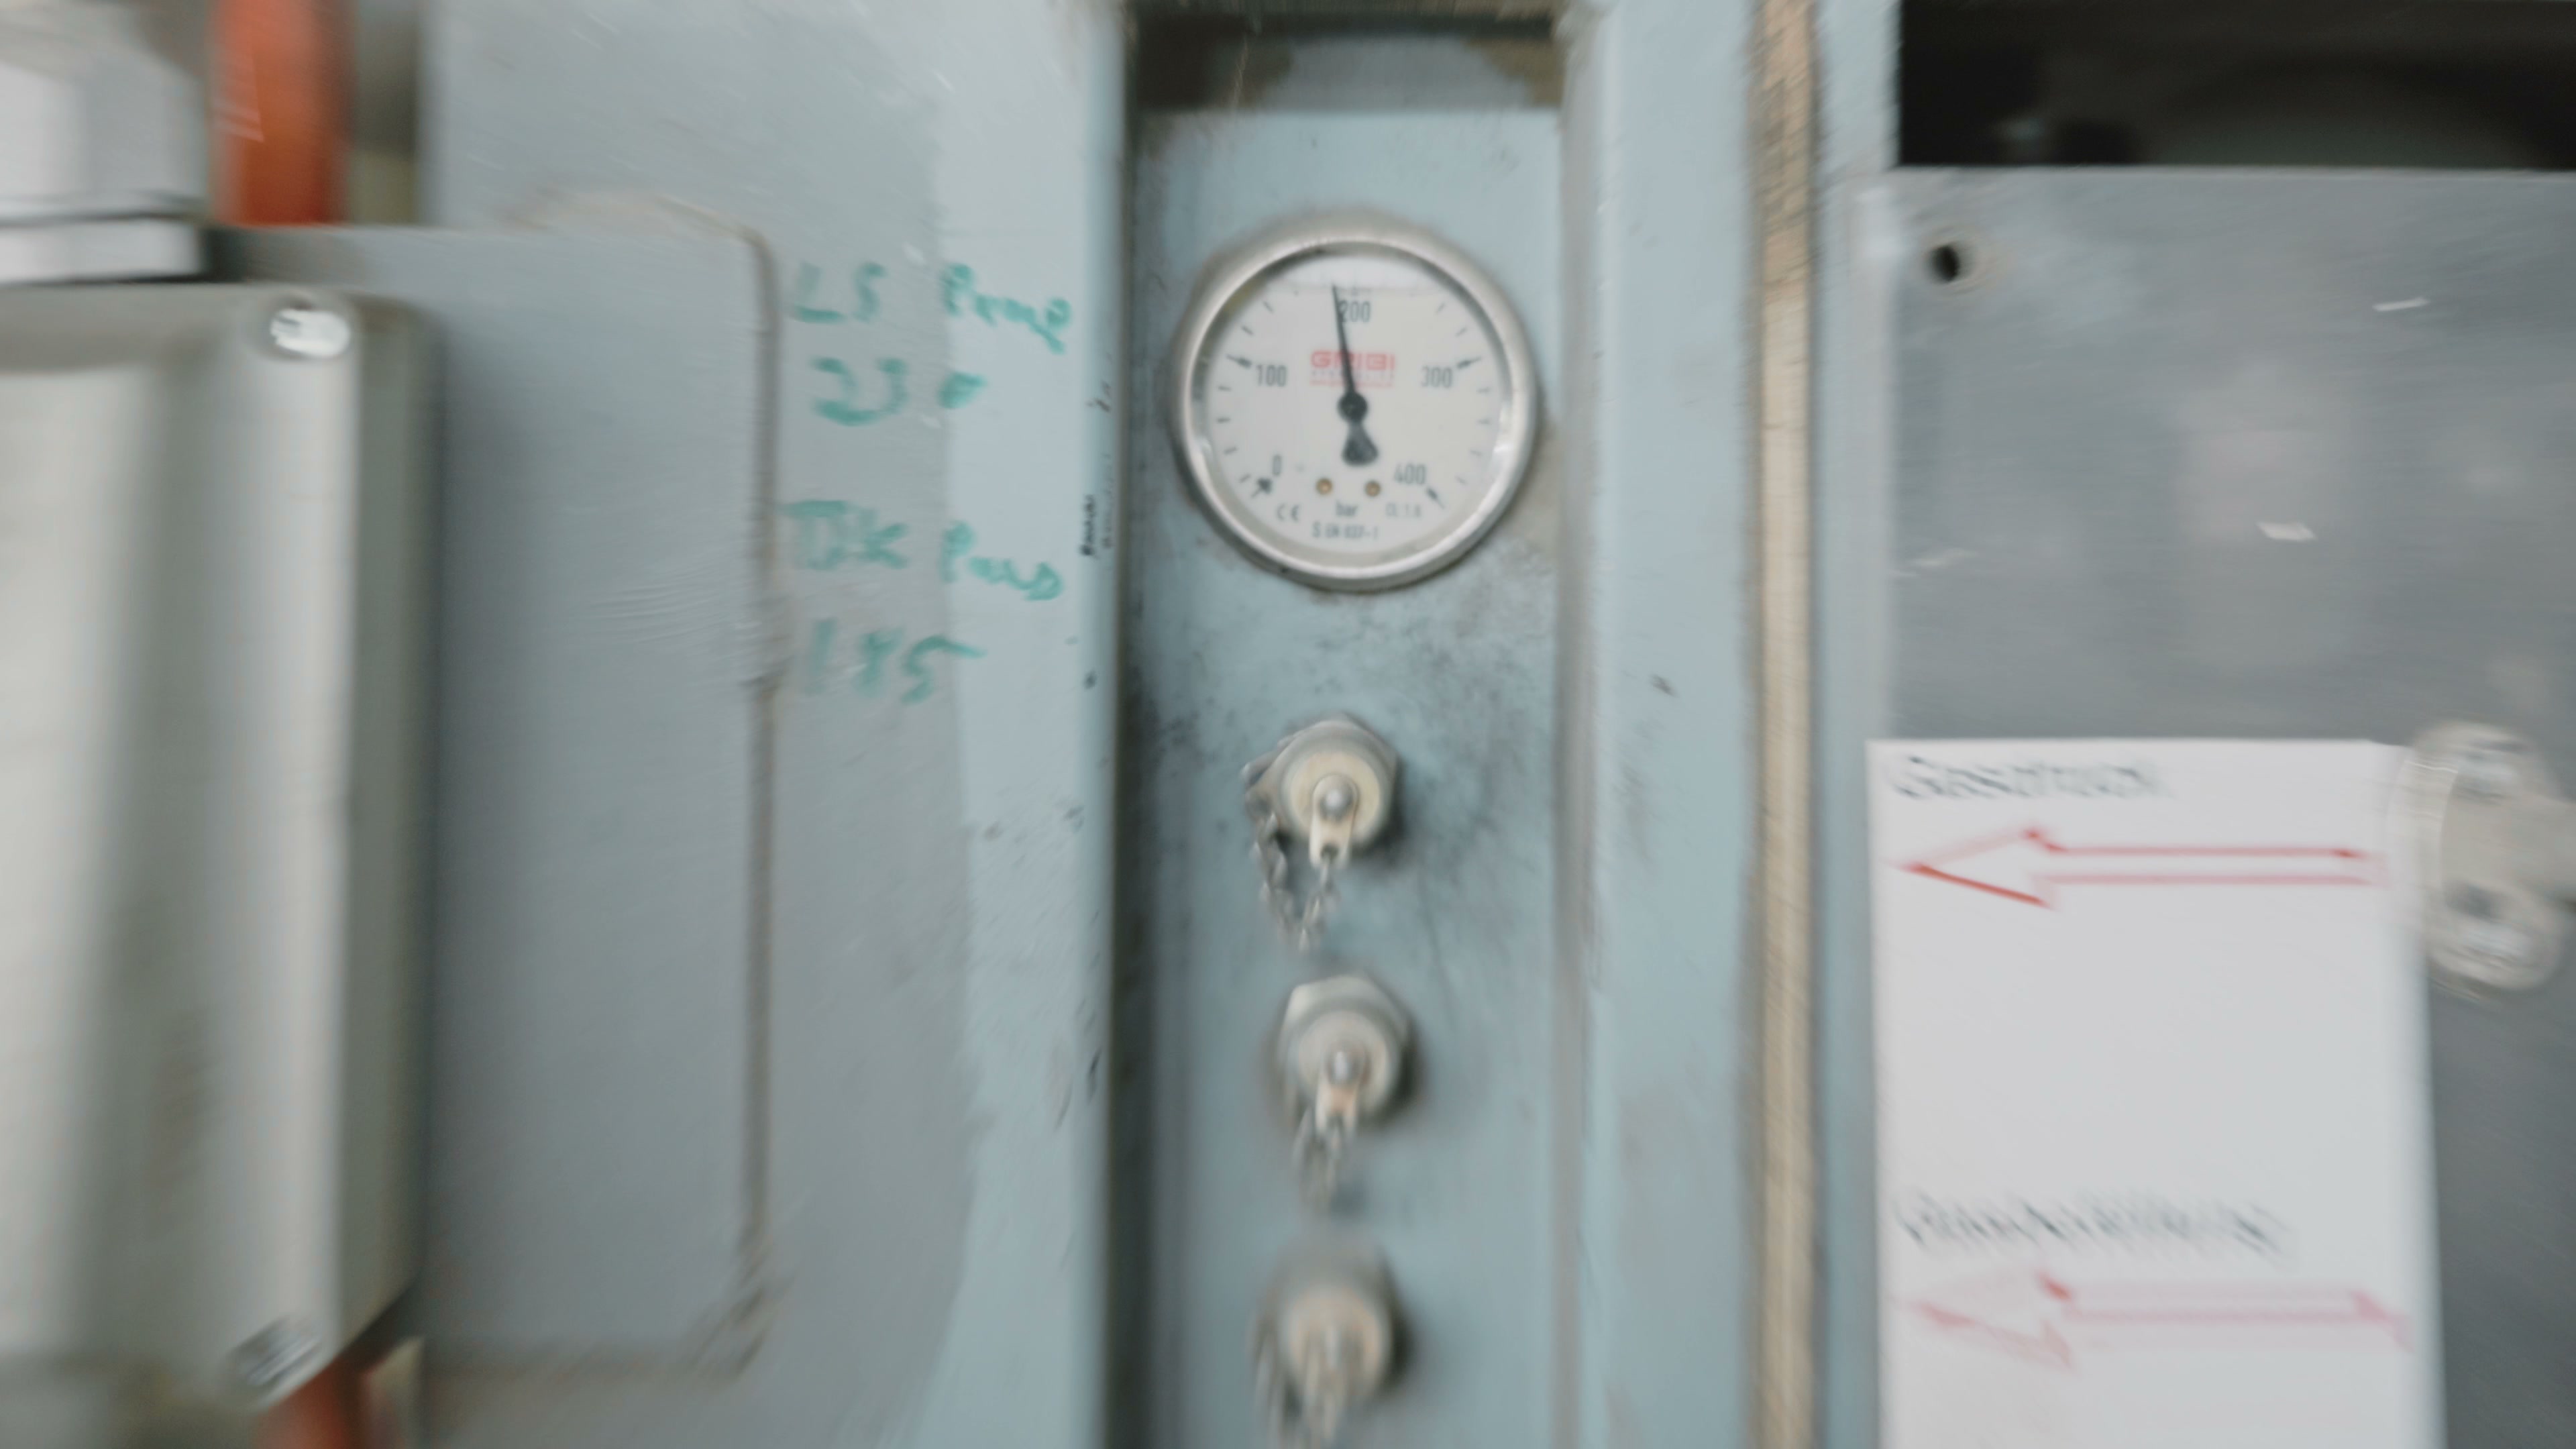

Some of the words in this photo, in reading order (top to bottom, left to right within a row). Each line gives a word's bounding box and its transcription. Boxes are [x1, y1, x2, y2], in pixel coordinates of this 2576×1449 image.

[1340, 300, 1371, 323] 200
[1256, 364, 1287, 387] 100
[1421, 366, 1452, 388] 300
[1271, 455, 1282, 477] 0
[1394, 464, 1426, 486] 400
[1335, 500, 1358, 517] bar
